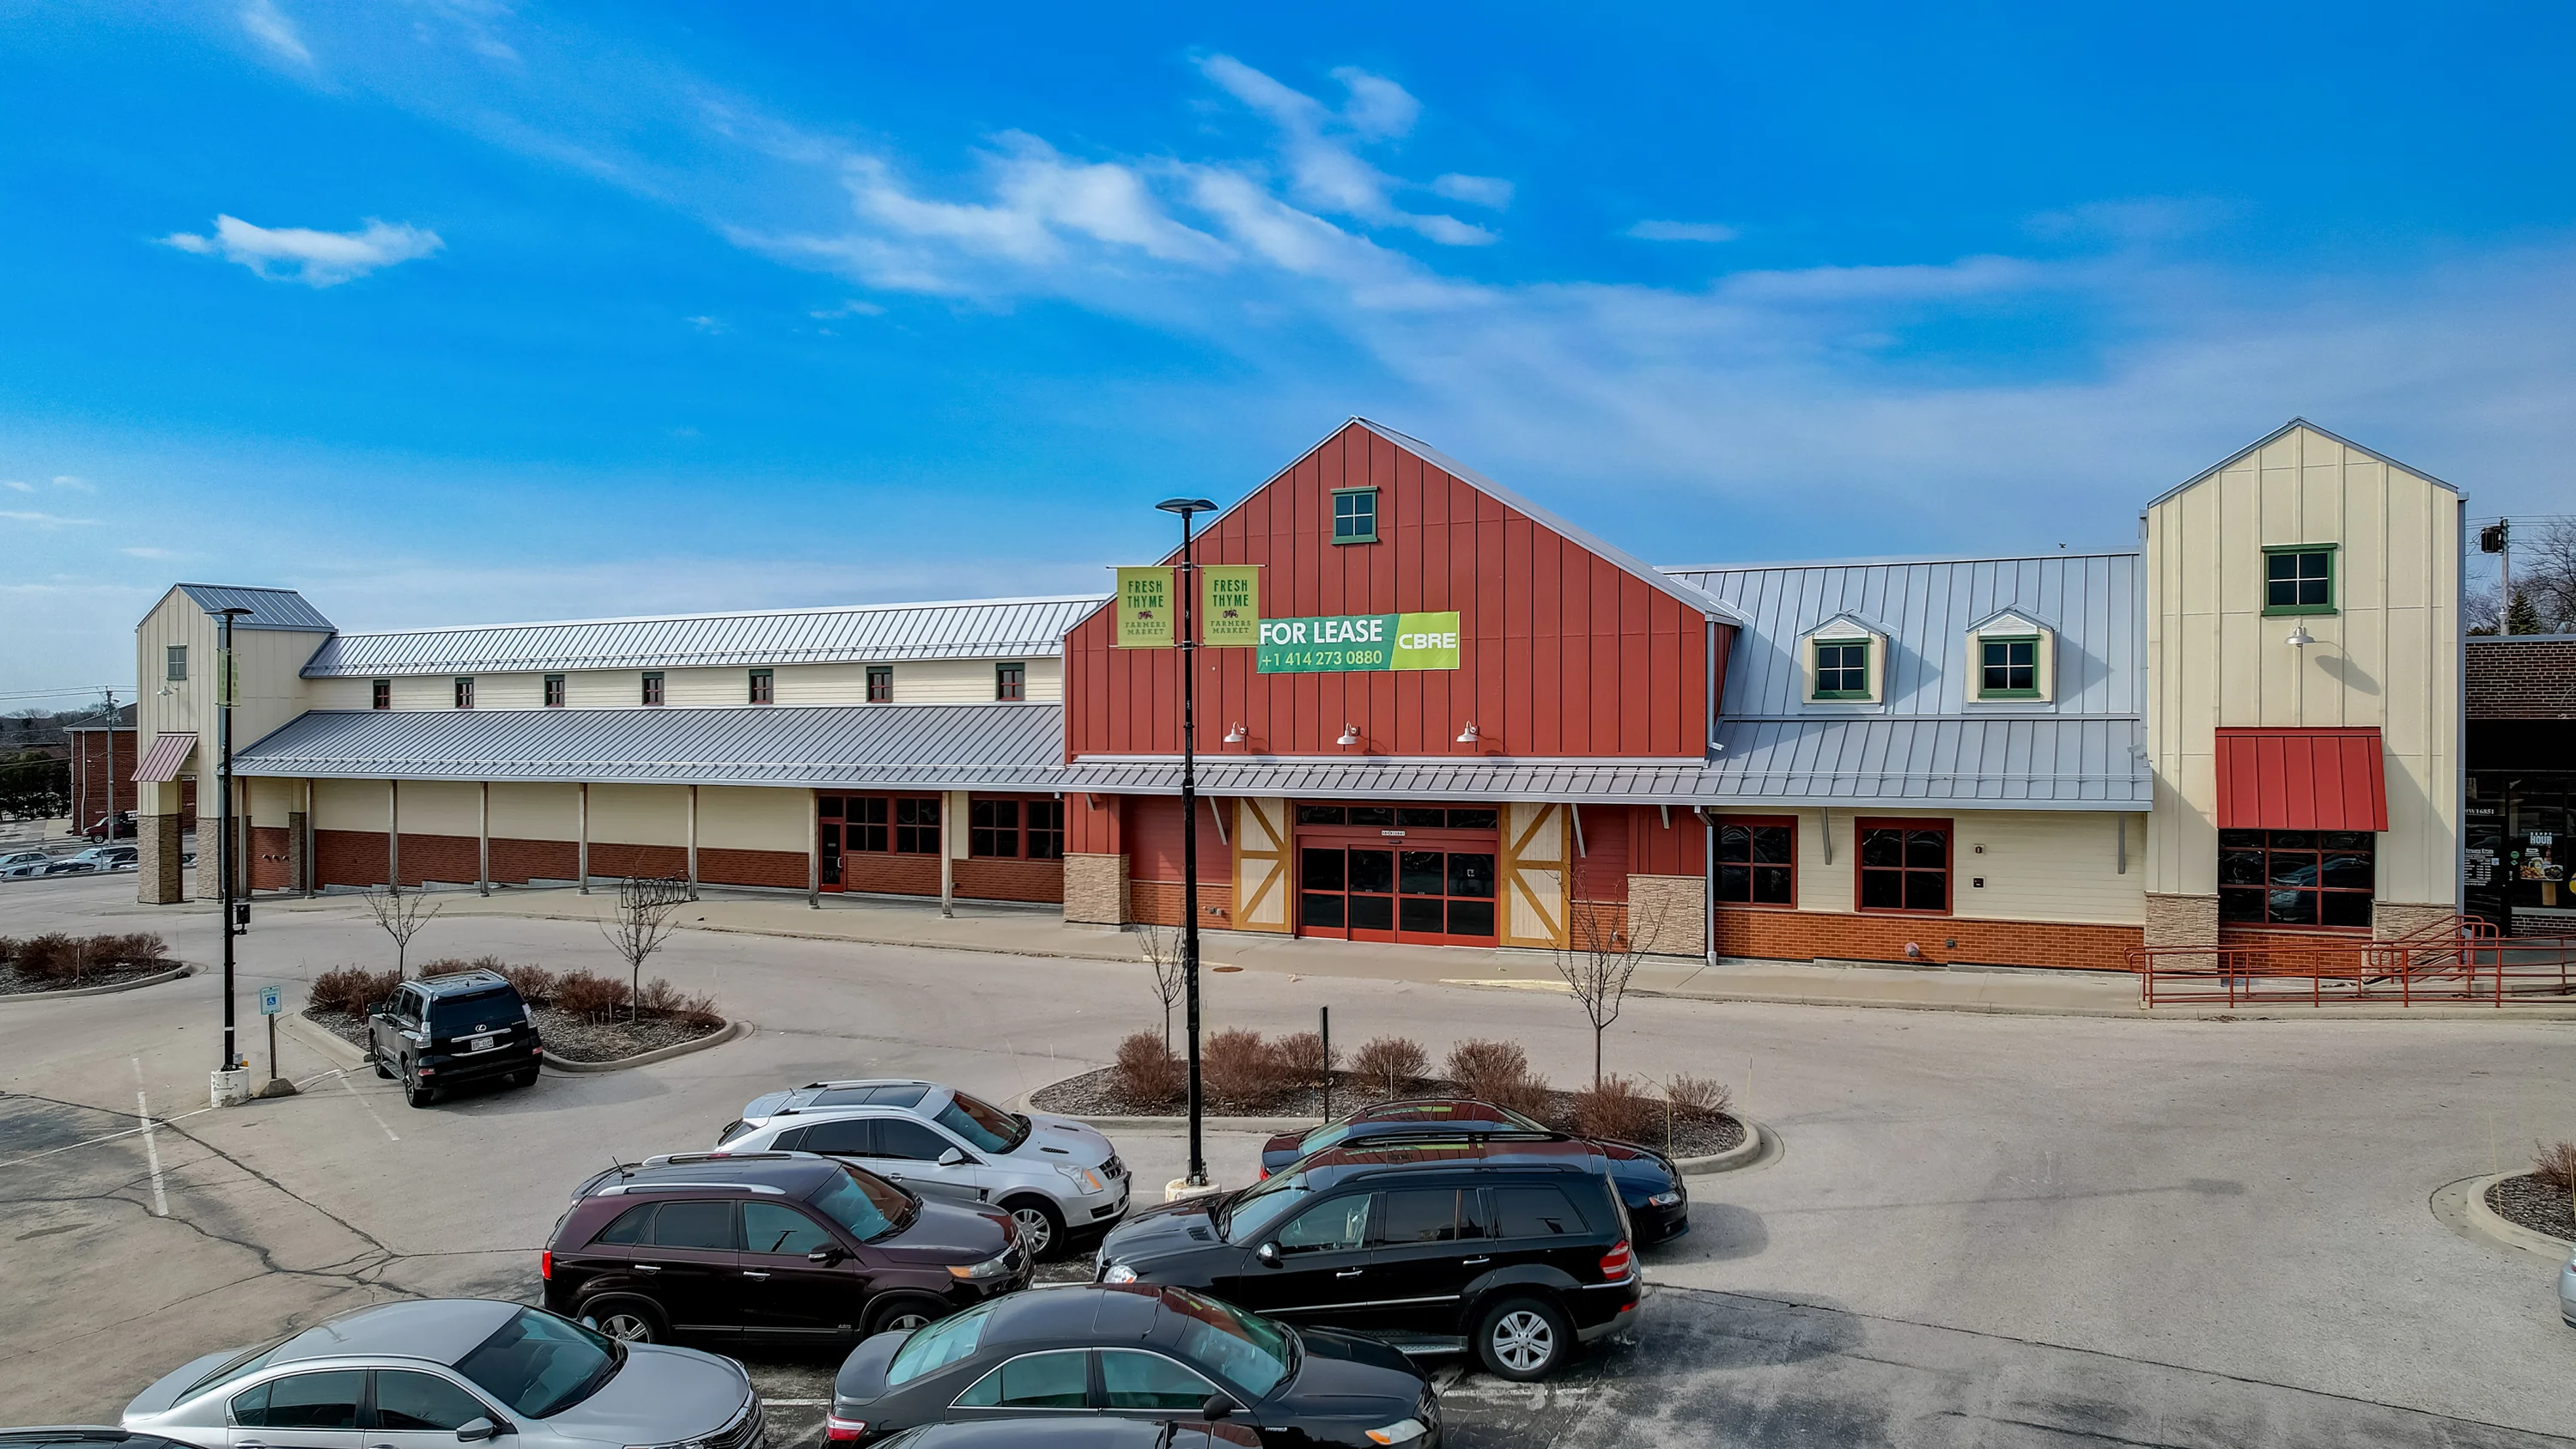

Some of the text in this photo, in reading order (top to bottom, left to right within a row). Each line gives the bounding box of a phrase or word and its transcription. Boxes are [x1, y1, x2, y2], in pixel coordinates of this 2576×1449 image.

[1128, 581, 1163, 594] FRESH
[1213, 580, 1248, 592] FRESH
[1127, 595, 1163, 608] THYME
[1212, 594, 1249, 606] THYME
[1260, 619, 1382, 645] FOR LEASE
[1398, 632, 1456, 649] CBRE
[1262, 649, 1382, 667] +1 414 273 0880
[2530, 835, 2552, 844] HOUR
